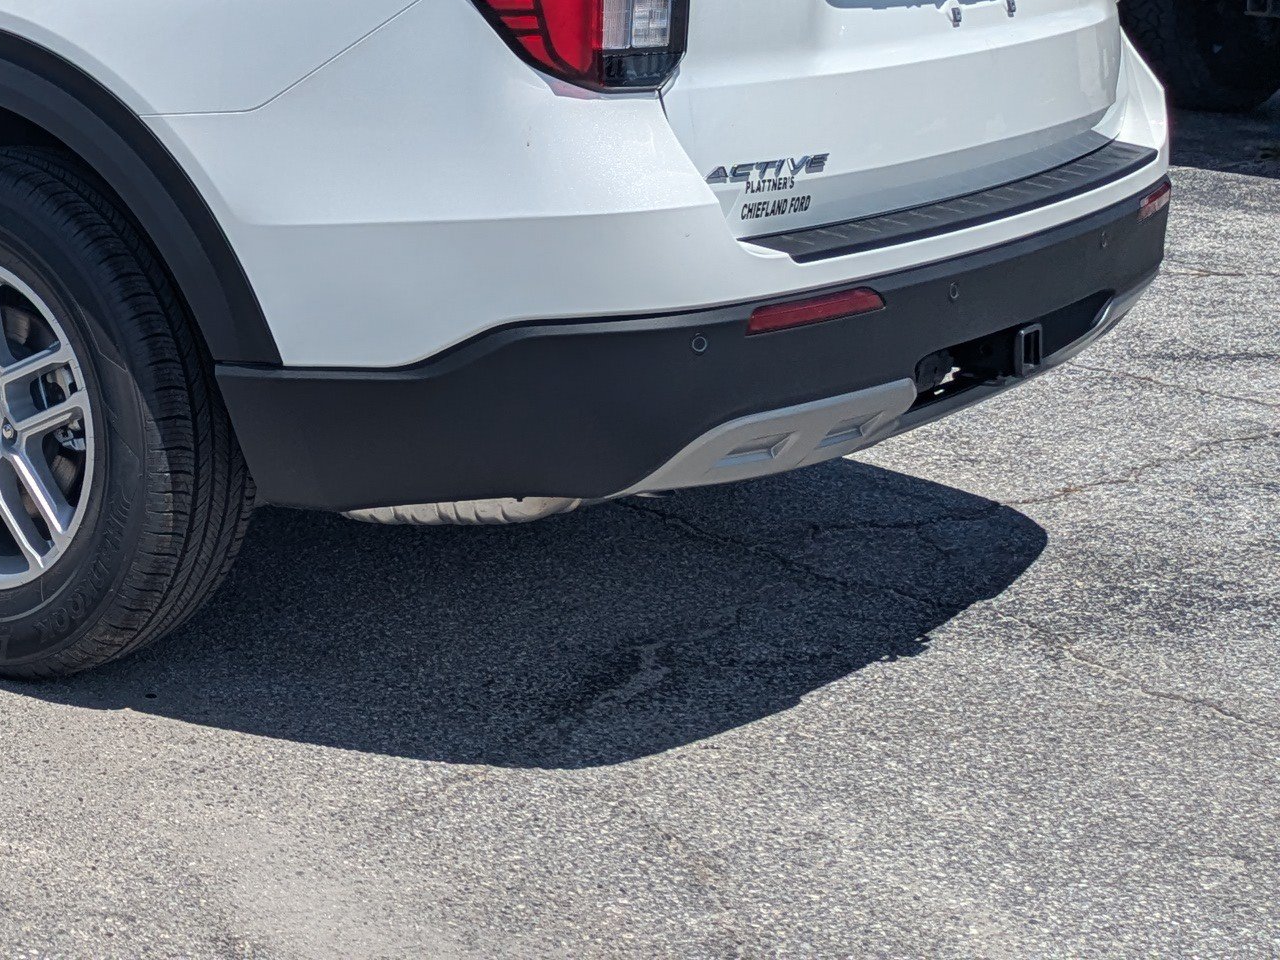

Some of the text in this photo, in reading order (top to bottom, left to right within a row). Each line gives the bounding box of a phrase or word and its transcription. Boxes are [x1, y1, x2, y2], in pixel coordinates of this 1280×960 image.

[703, 153, 830, 182] ACTIVE
[745, 176, 795, 194] PLATTNER'S
[741, 195, 812, 220] CHIEFLAND FORD
